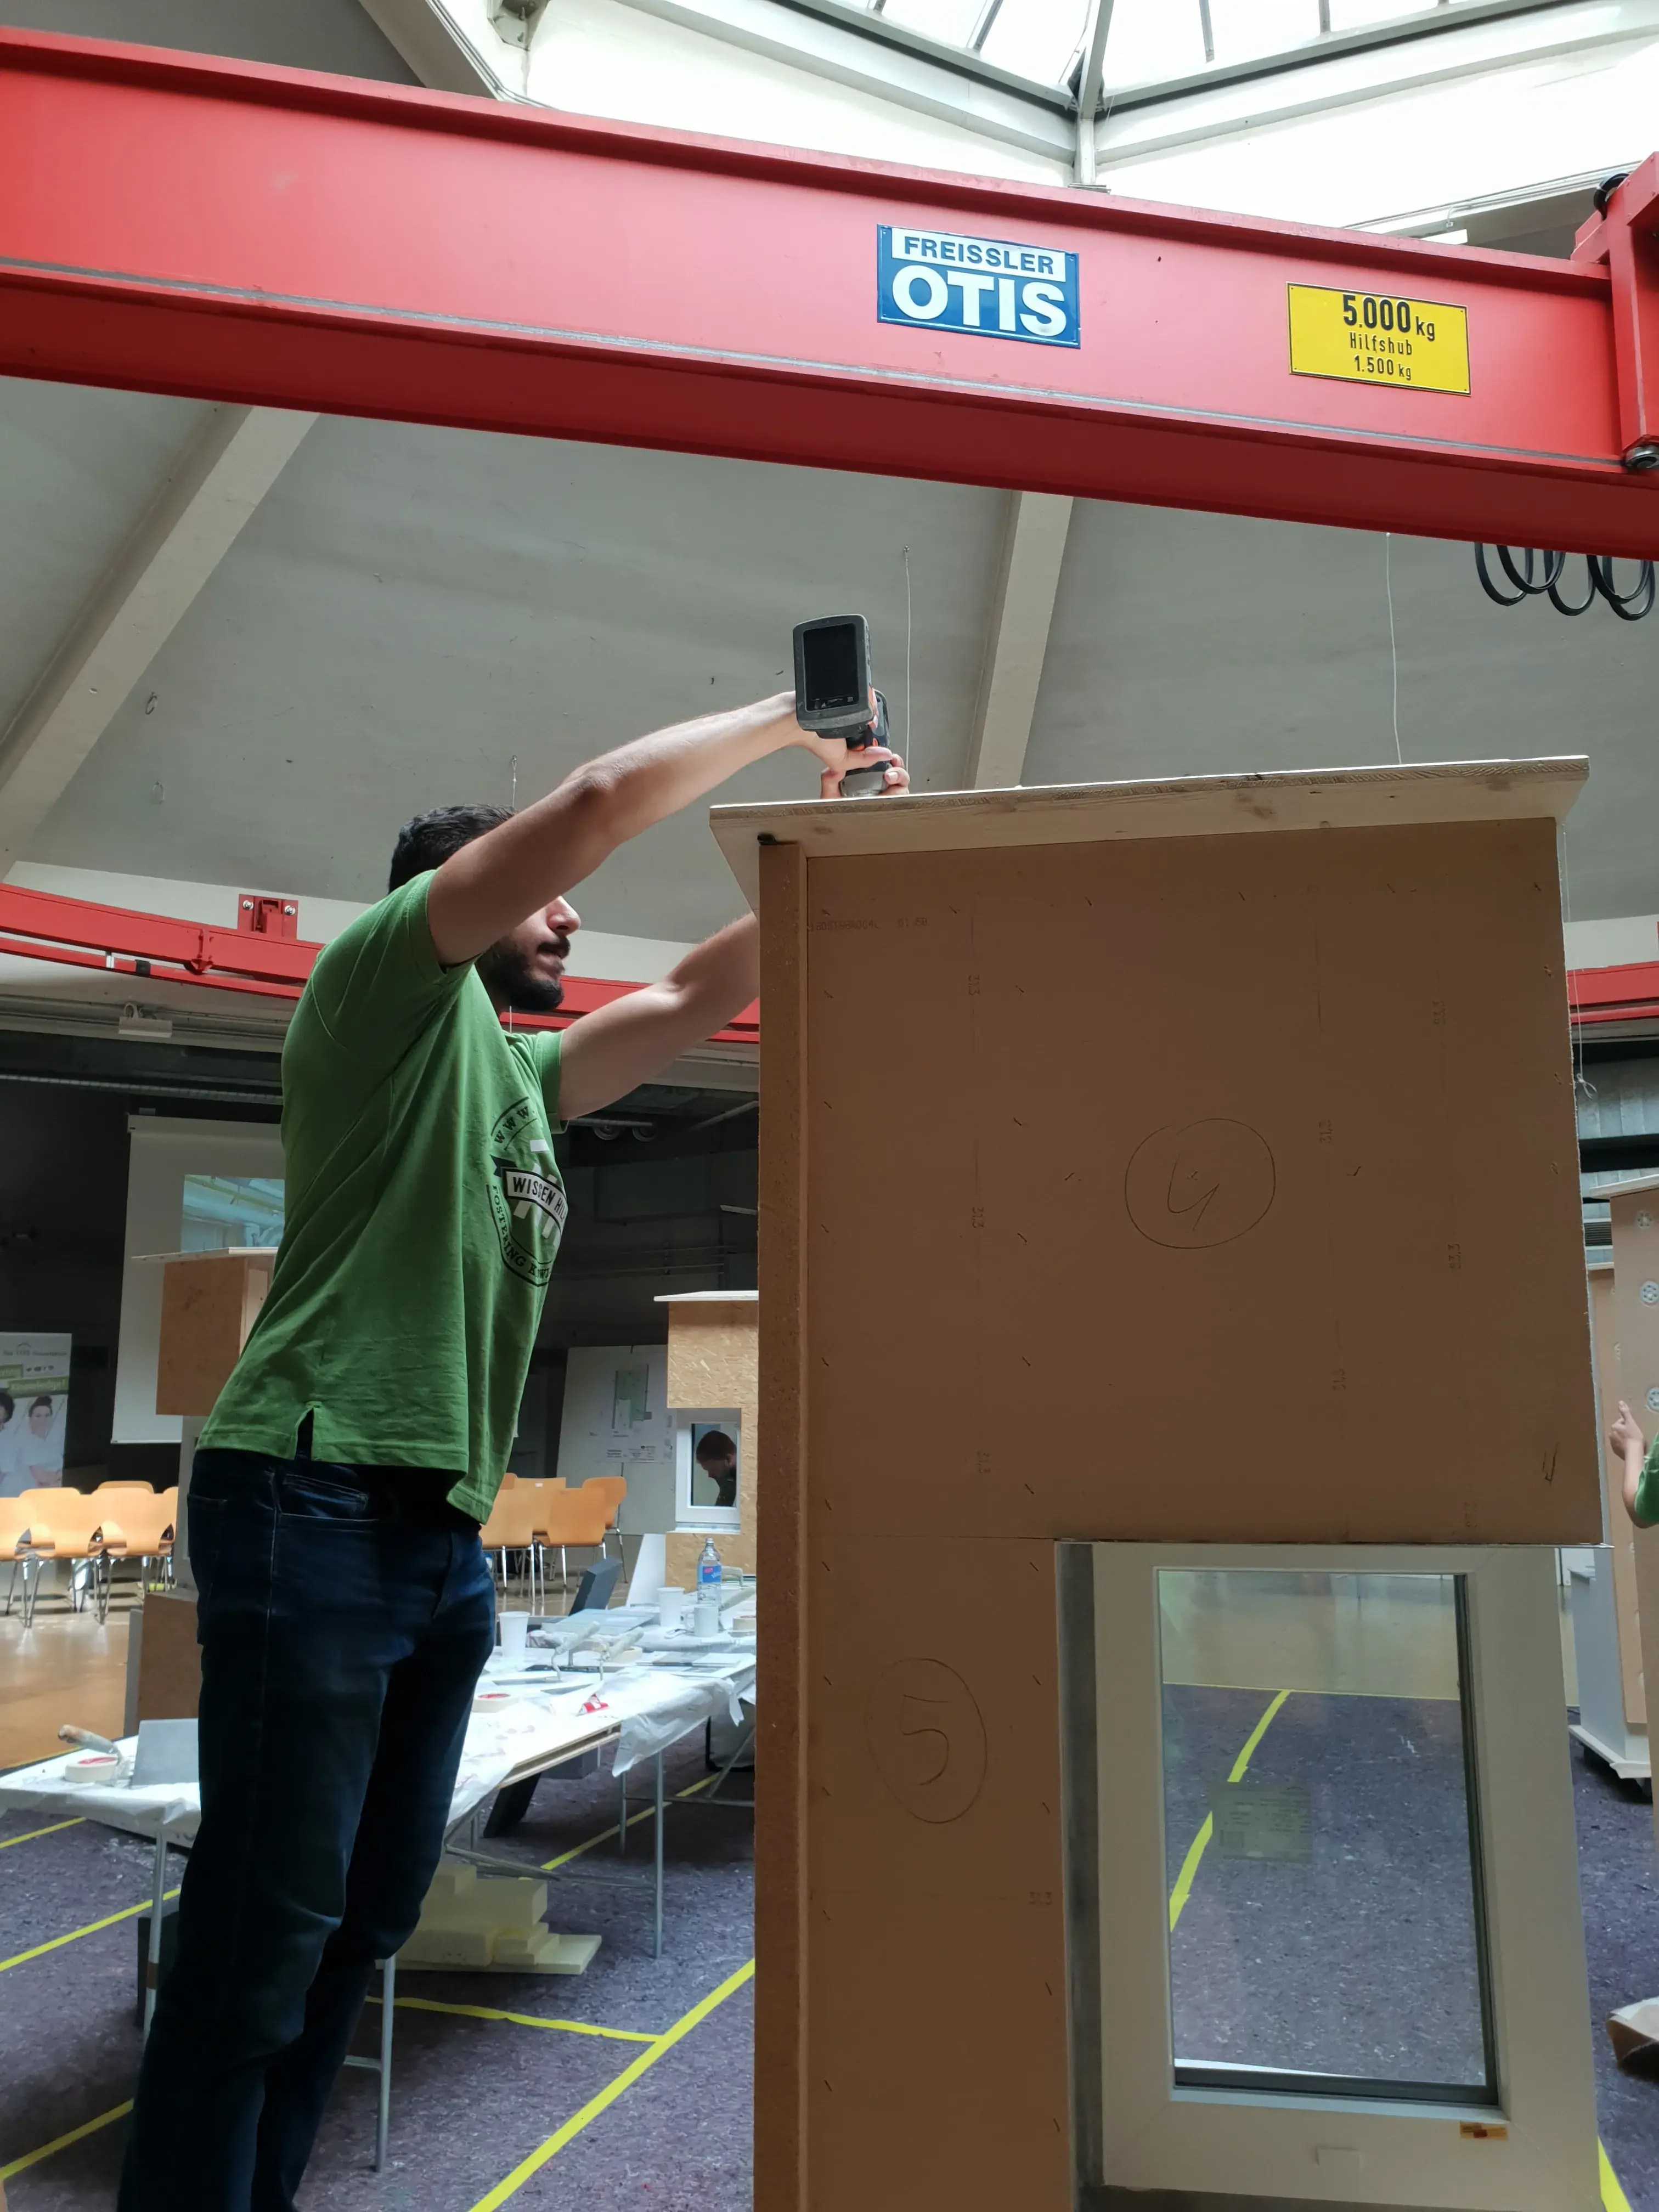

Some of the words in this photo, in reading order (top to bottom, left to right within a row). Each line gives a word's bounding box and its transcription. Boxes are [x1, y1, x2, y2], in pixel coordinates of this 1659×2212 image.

[904, 236, 1054, 275] FREISSLER
[892, 264, 1067, 337] OTIS
[1342, 294, 1410, 333] 5.000
[1416, 315, 1435, 342] kg
[1349, 331, 1413, 356] Hilfshub
[1354, 354, 1394, 376] 1.500
[1398, 362, 1412, 381] kg
[512, 1176, 556, 1206] WISSEN
